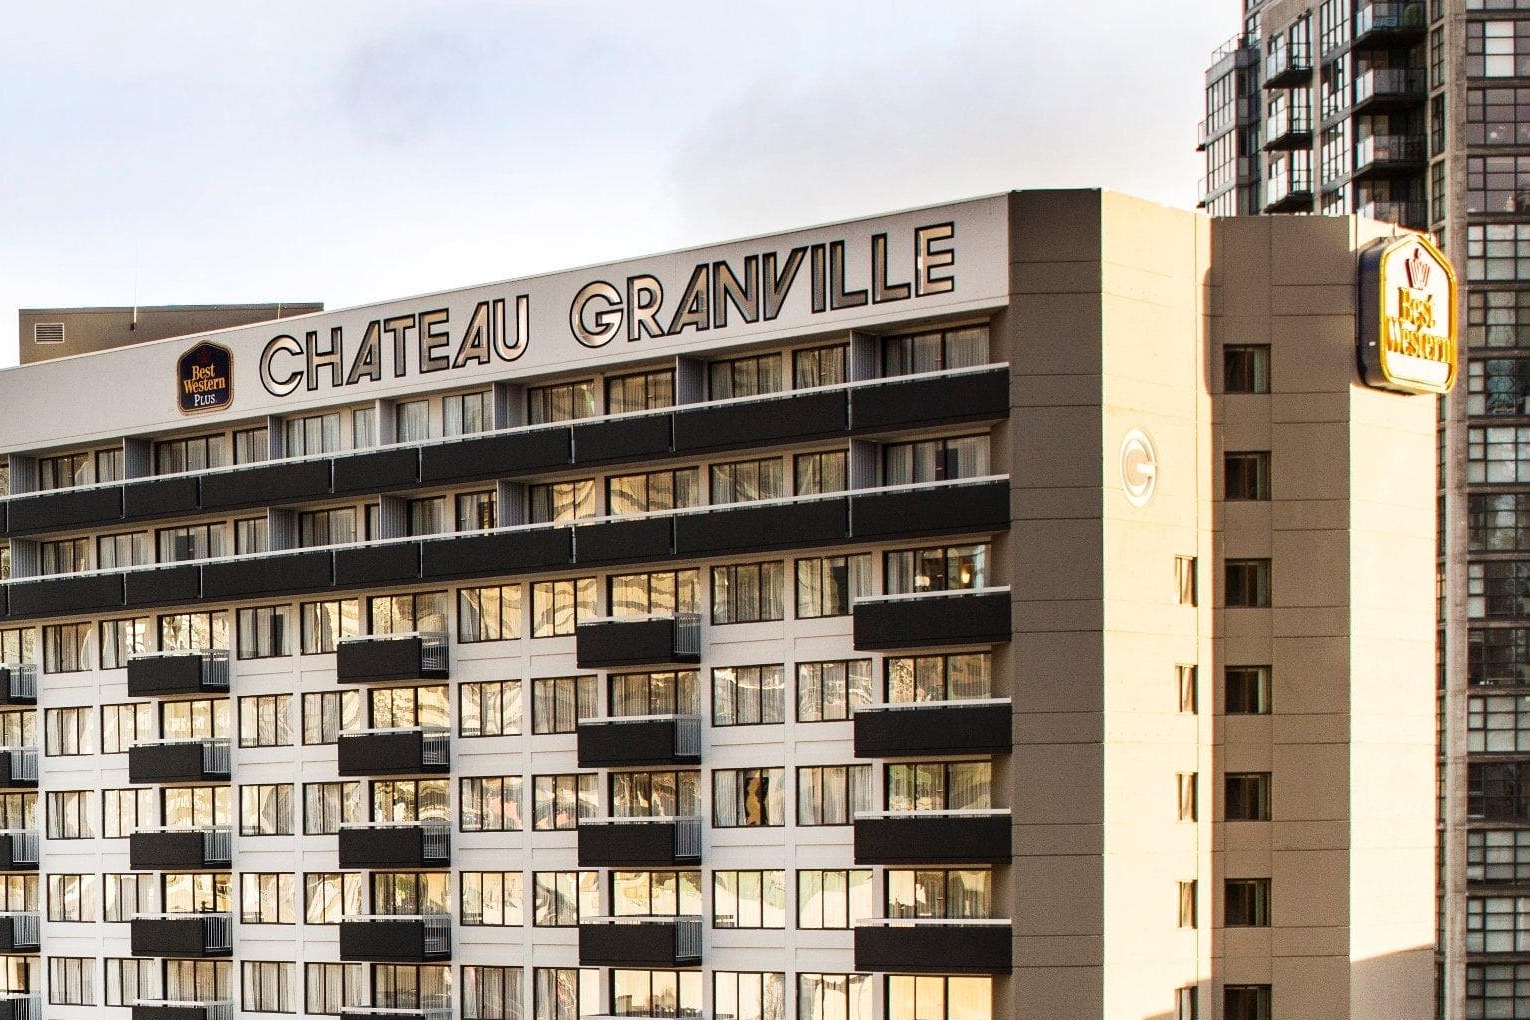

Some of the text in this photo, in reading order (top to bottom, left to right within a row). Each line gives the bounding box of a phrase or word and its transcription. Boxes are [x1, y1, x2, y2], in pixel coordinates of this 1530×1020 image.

[259, 221, 955, 397] CHATEAU GRANVILLE
[1398, 286, 1435, 328] Best
[1384, 316, 1452, 364] Western
[183, 377, 227, 394] Western
[192, 362, 216, 380] Best
